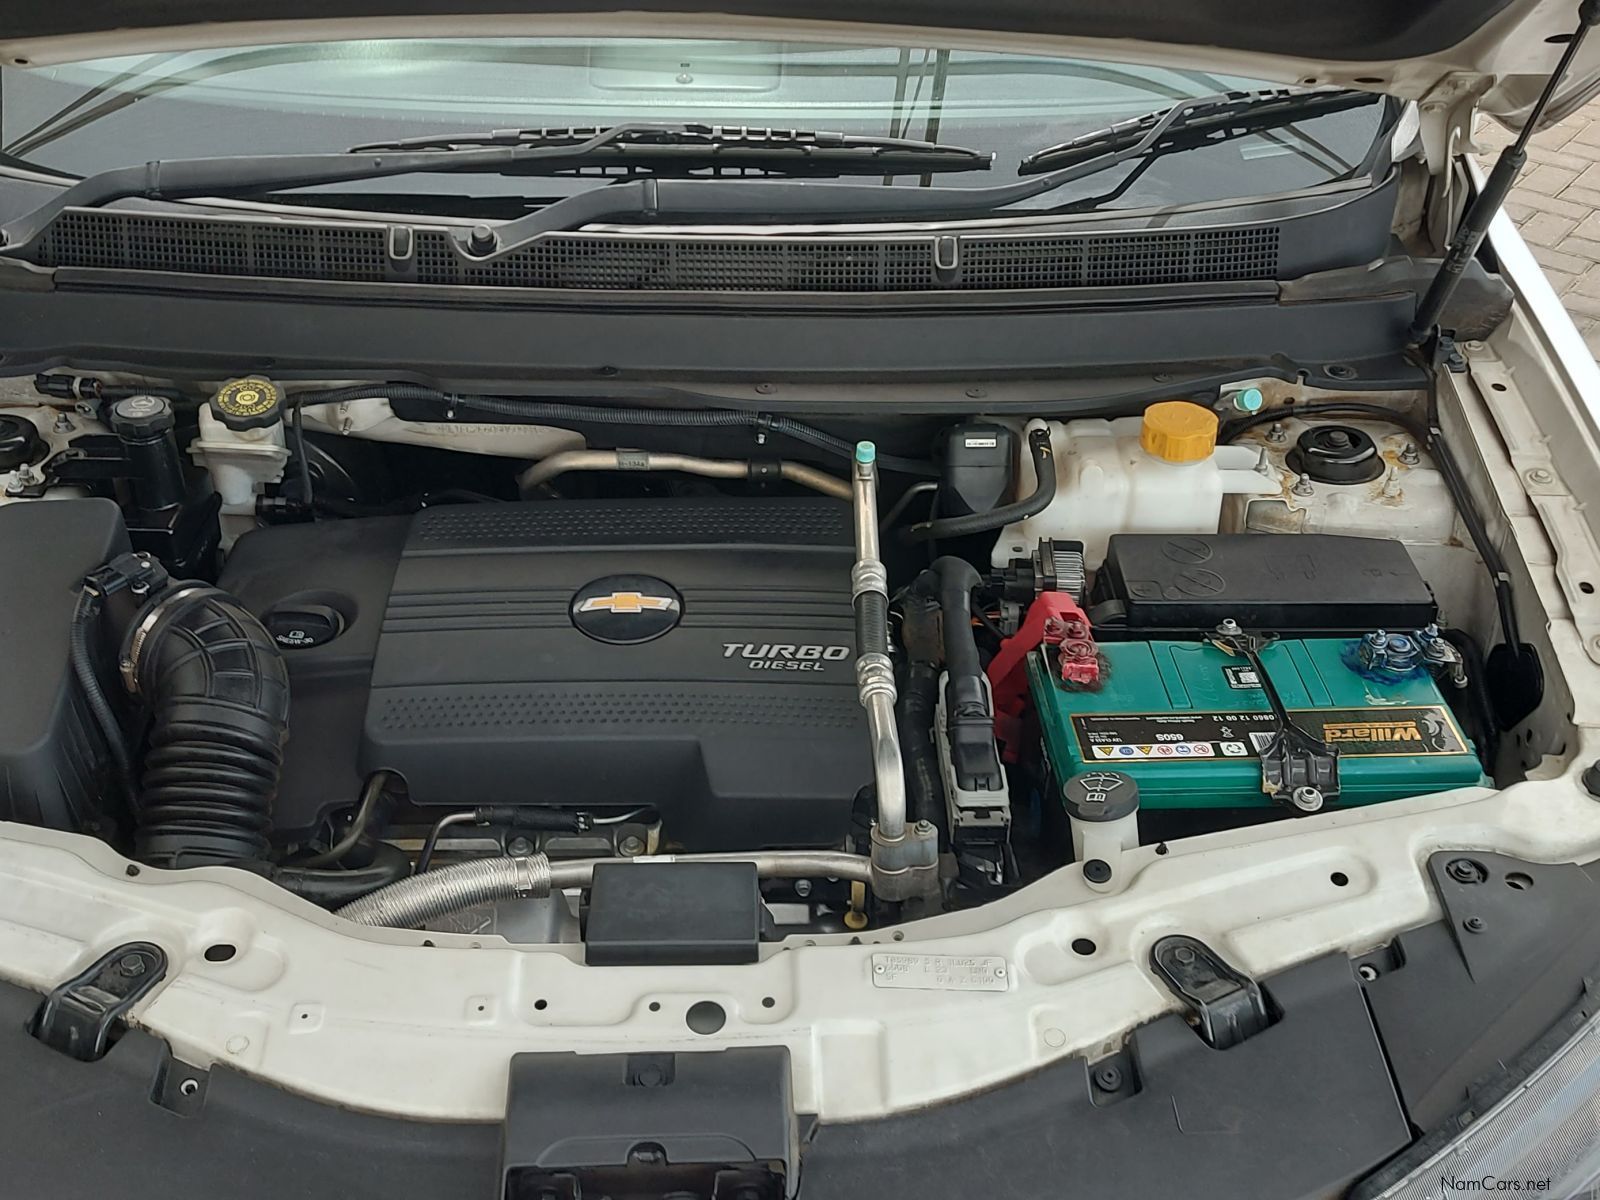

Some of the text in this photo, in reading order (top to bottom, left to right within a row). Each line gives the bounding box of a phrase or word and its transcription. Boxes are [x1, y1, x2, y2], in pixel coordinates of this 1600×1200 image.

[723, 643, 850, 660] TURBO
[749, 660, 825, 671] DIESEL
[1155, 733, 1184, 741] 650S
[1324, 727, 1422, 743] Willard
